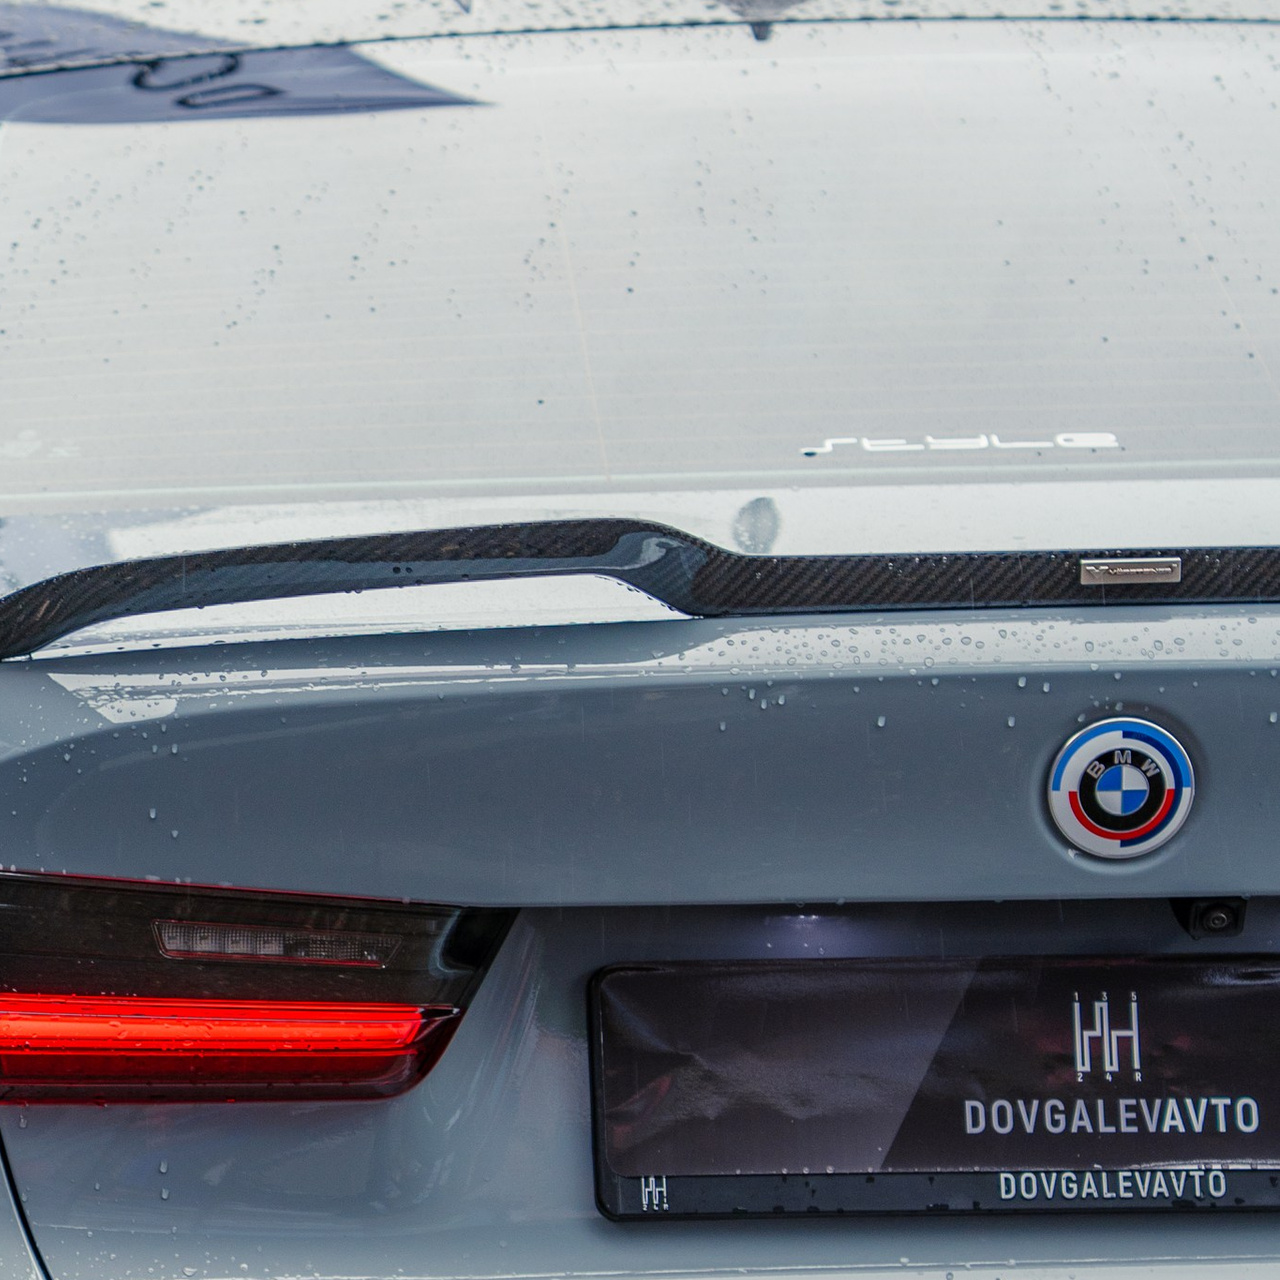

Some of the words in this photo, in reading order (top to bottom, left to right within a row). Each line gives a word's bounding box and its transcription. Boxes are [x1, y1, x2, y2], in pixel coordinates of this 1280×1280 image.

[1086, 750, 1160, 779] BMW
[965, 1097, 1259, 1134] DOVGALEVAVTO
[999, 1170, 1227, 1199] DOVGALEVAVTO
